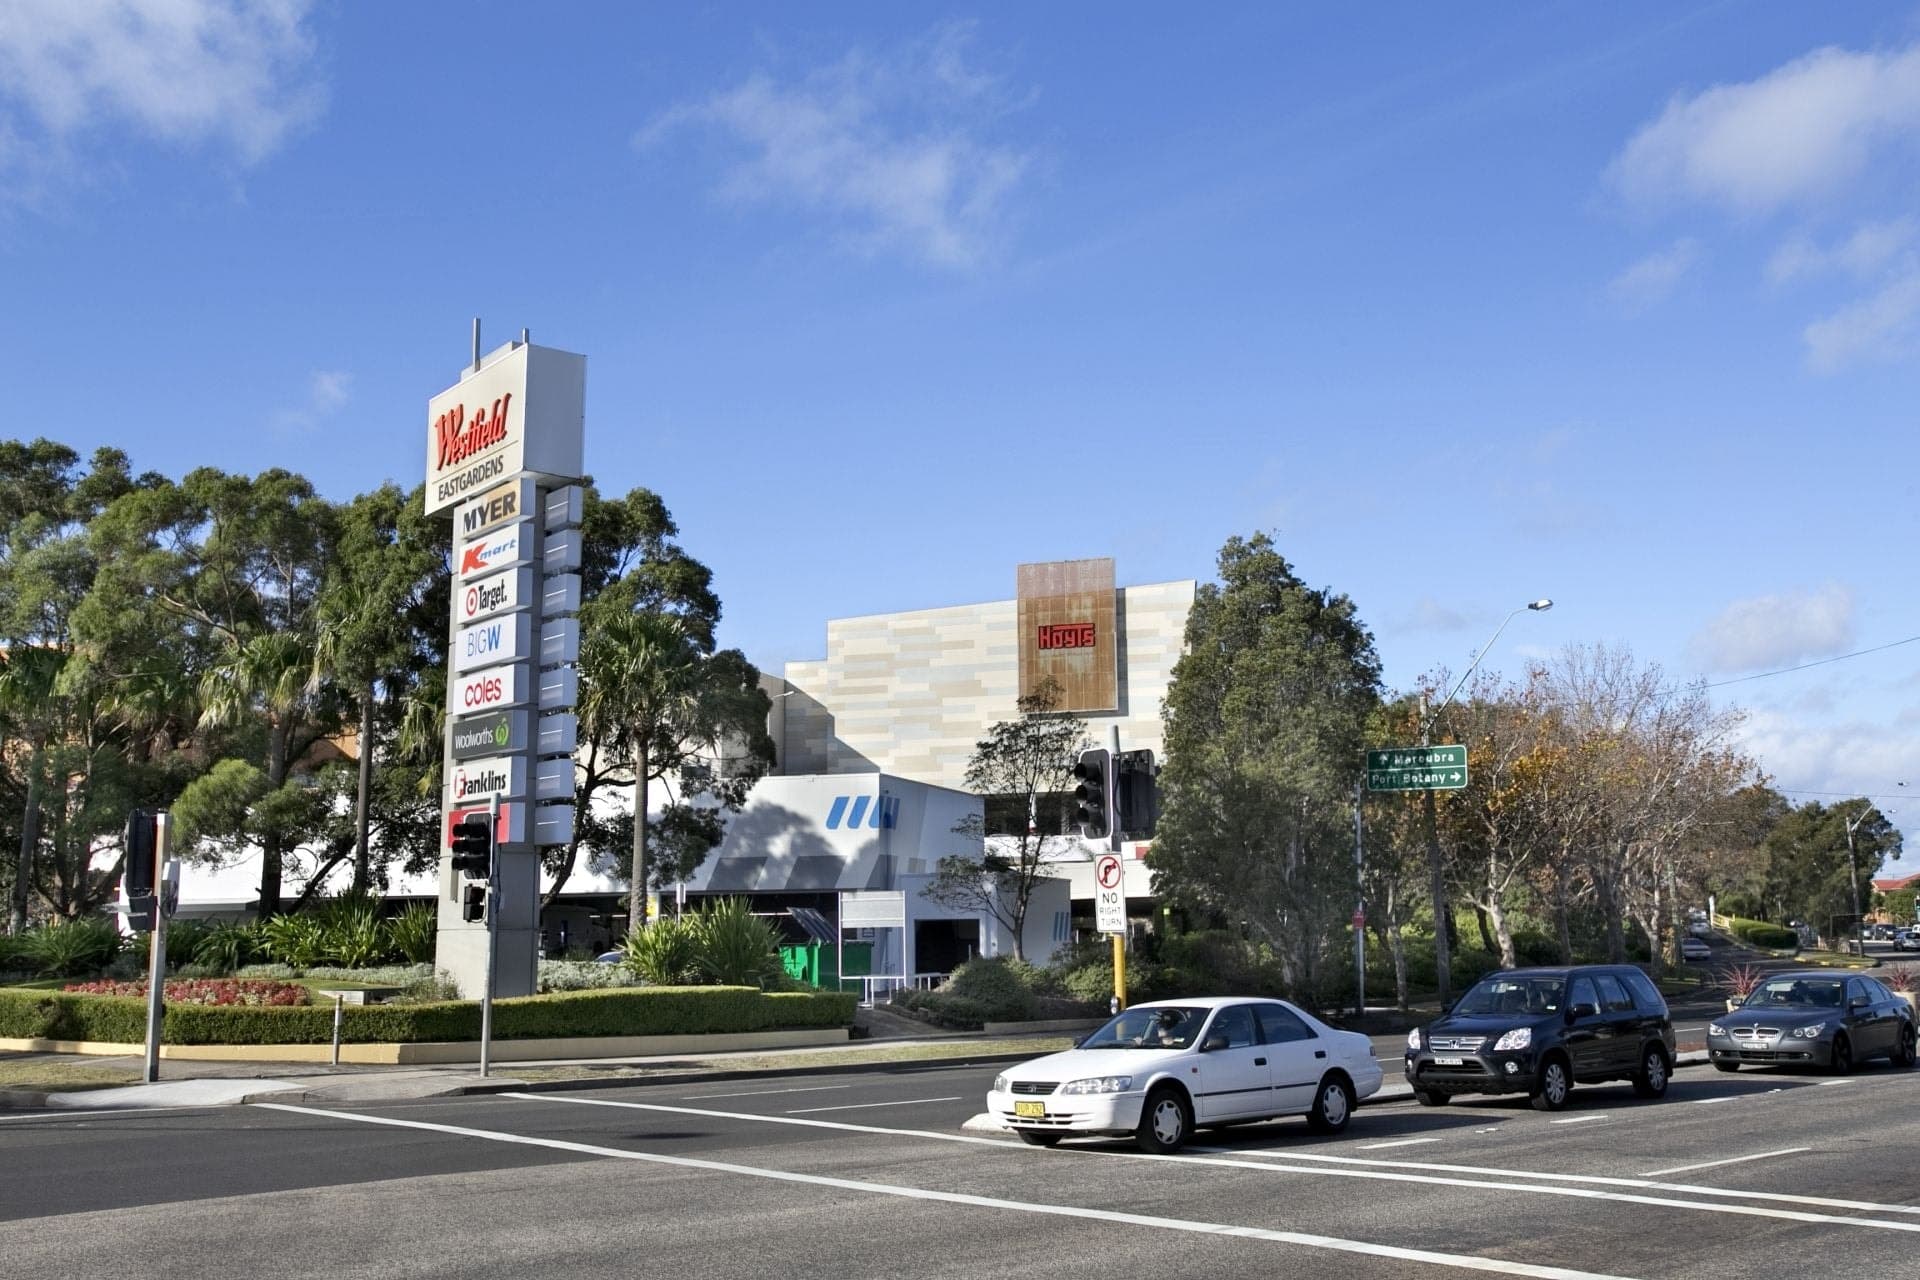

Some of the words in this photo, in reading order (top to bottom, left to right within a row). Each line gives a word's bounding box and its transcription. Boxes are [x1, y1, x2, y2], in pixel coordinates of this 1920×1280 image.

[435, 393, 512, 471] Westfield
[438, 455, 503, 502] EASTGARDENS
[463, 490, 516, 533] MYER
[461, 540, 517, 575] Kmart
[464, 675, 502, 707] coles
[1394, 752, 1455, 765] Maroubra
[1372, 774, 1397, 785] Port
[1403, 771, 1446, 785] Botany
[1102, 892, 1118, 904] NO
[1099, 906, 1121, 915] RIGHT
[1101, 918, 1122, 927] TURN
